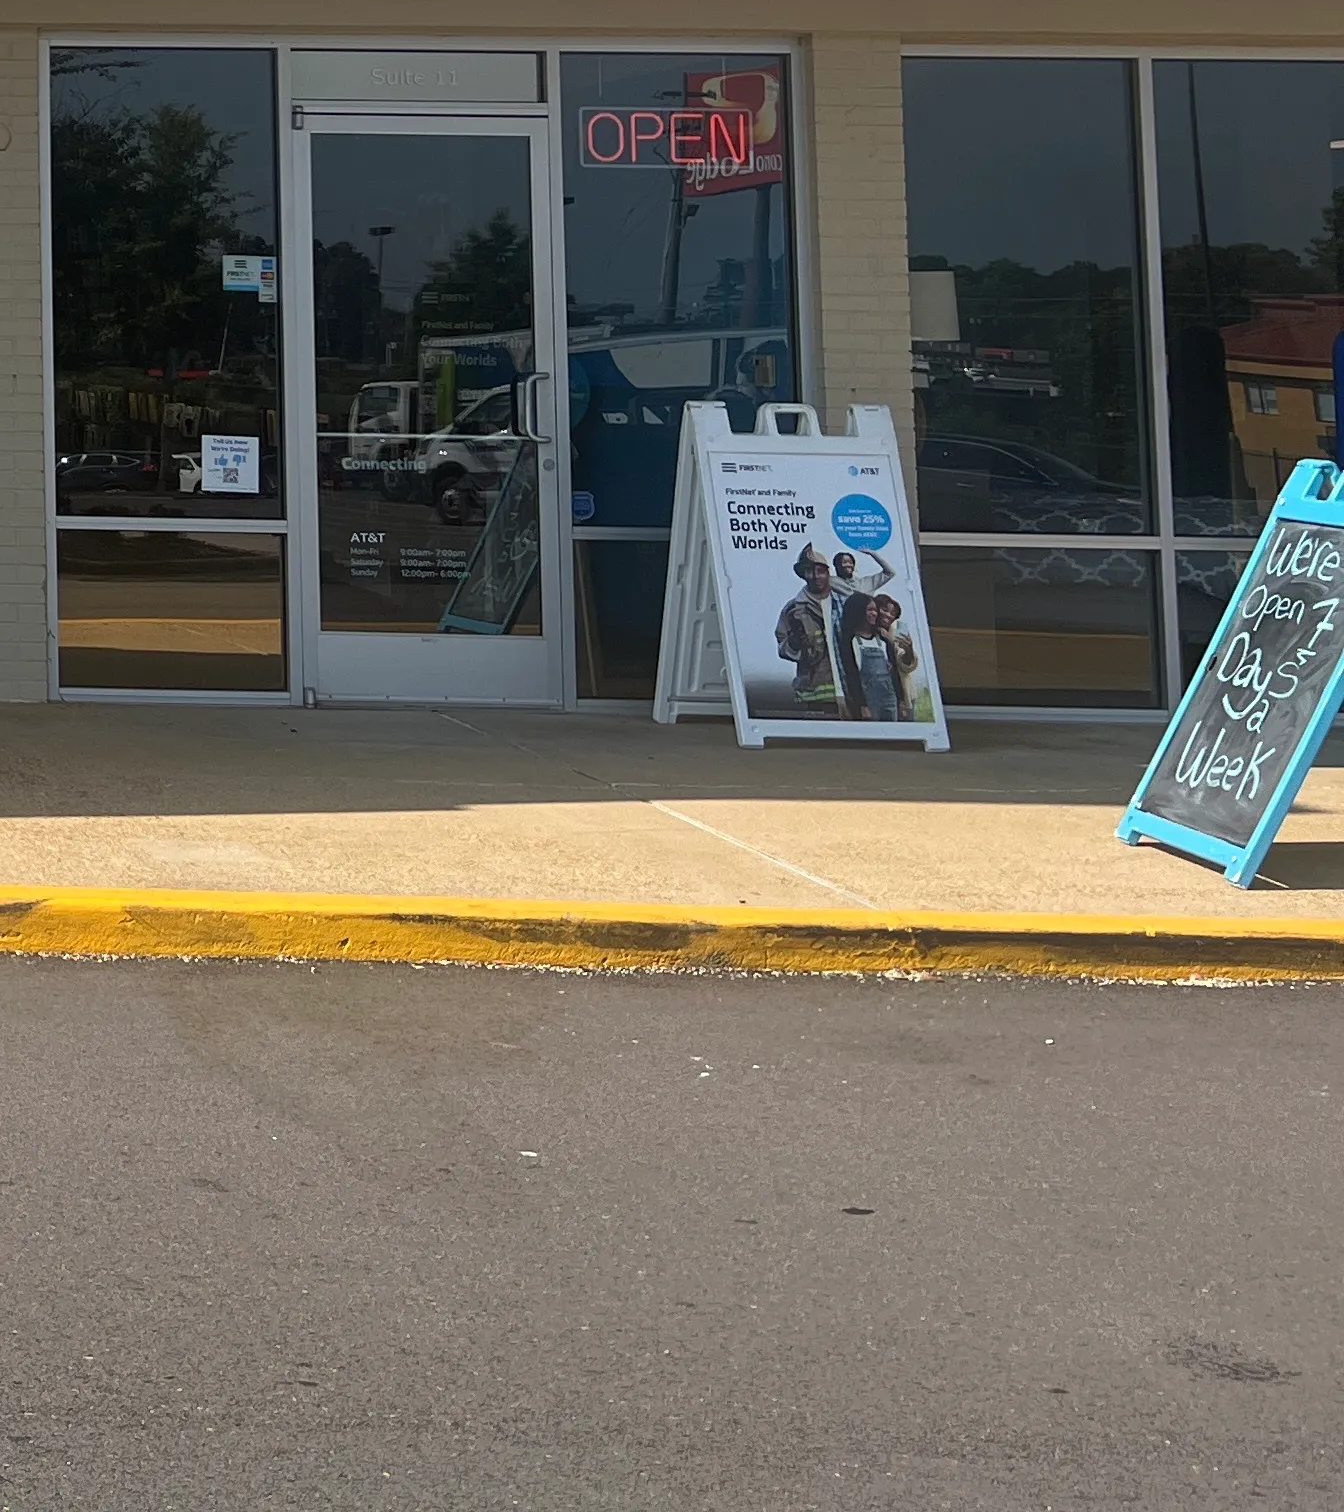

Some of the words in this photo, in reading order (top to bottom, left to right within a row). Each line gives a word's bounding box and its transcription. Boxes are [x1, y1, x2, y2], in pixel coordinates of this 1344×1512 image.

[371, 68, 425, 88] Suite
[587, 112, 745, 164] OPEN
[453, 354, 497, 367] Worlds
[341, 457, 427, 473] Connecting
[757, 489, 771, 497] and
[772, 490, 797, 498] Family
[728, 501, 816, 519] Connecting
[730, 518, 768, 533] Both
[772, 519, 808, 534] Your
[863, 515, 885, 524] 25%
[350, 533, 386, 543] AT&T
[732, 535, 789, 550] Worlds
[1241, 585, 1305, 631] Open
[1216, 632, 1300, 720] Days
[1247, 698, 1269, 734] a
